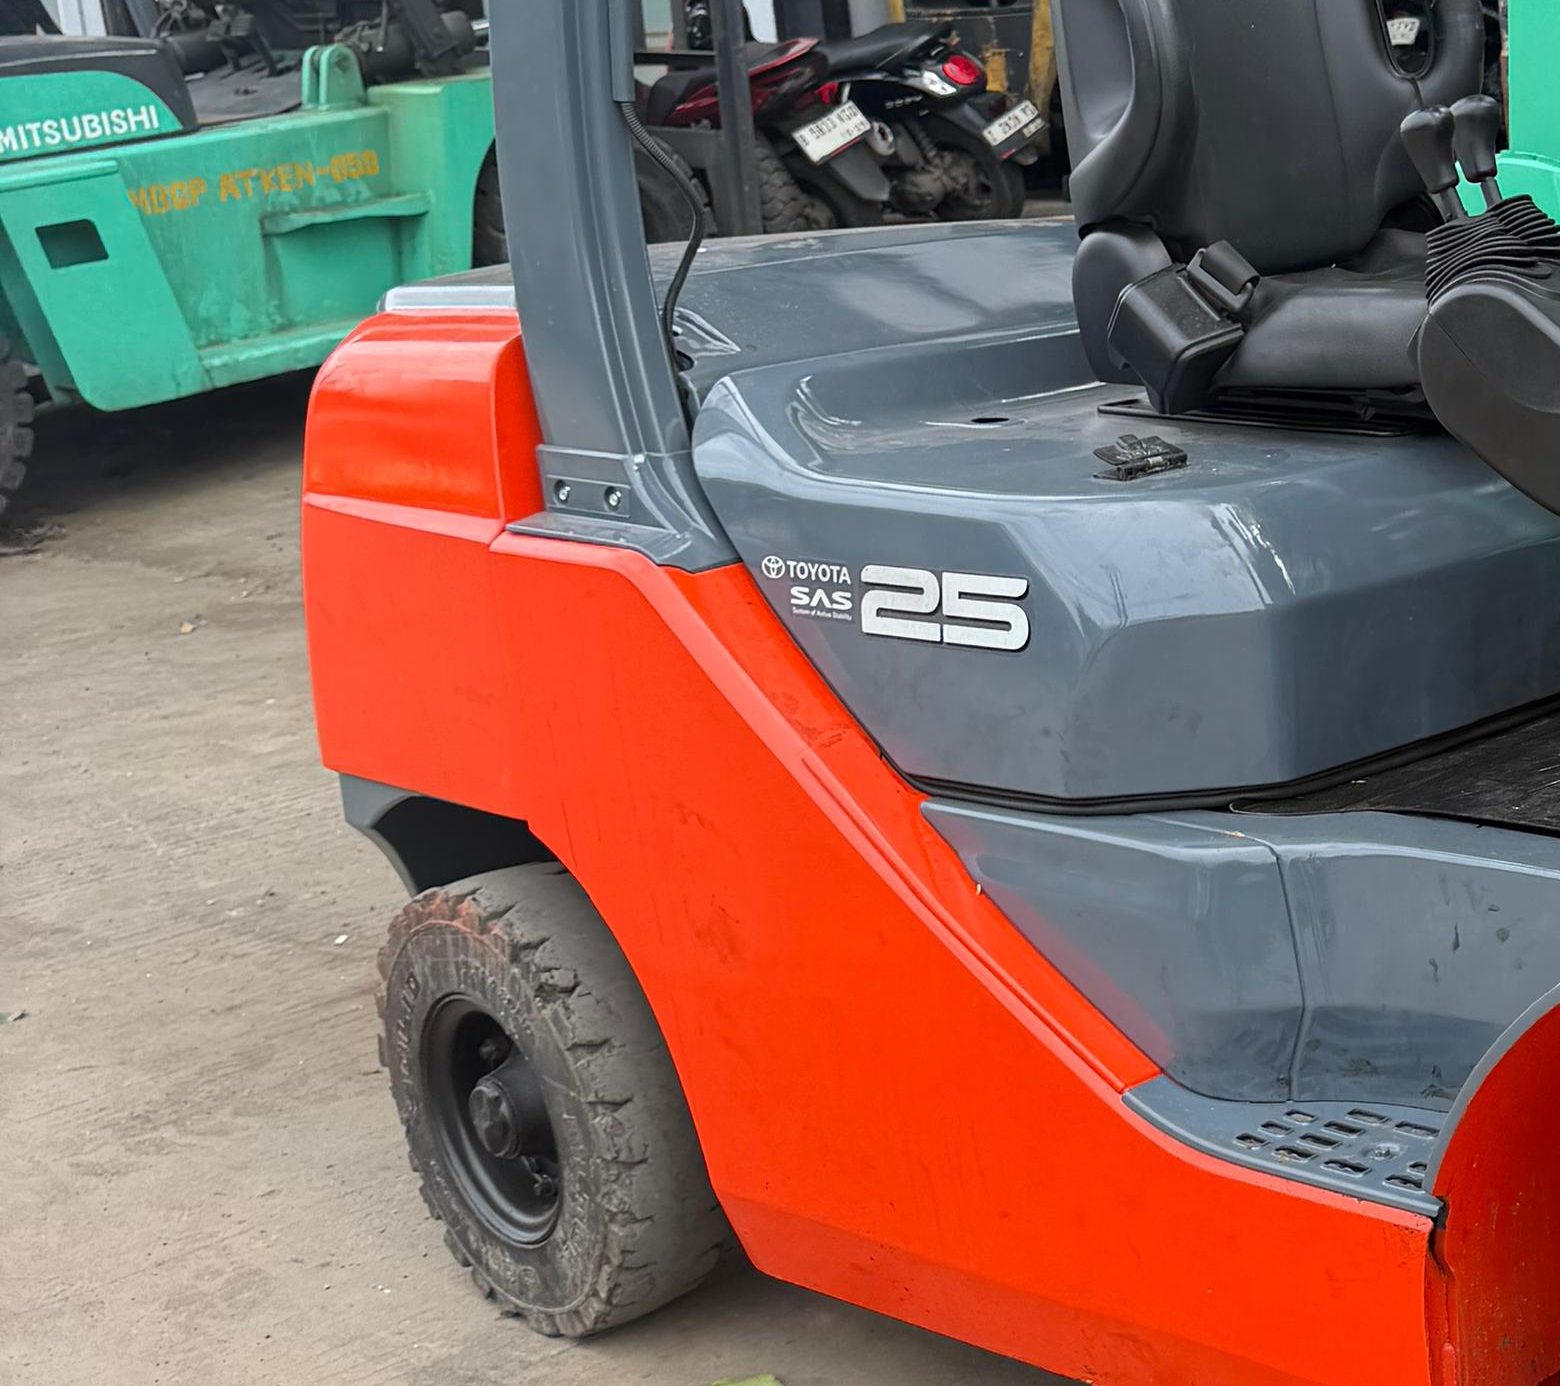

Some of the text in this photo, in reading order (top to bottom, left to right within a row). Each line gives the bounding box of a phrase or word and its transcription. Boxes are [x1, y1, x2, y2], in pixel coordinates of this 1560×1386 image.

[0, 105, 160, 153] MITSUBISHI
[786, 560, 852, 585] TOYOTA
[790, 586, 853, 610] SAS
[860, 564, 1030, 651] 25
